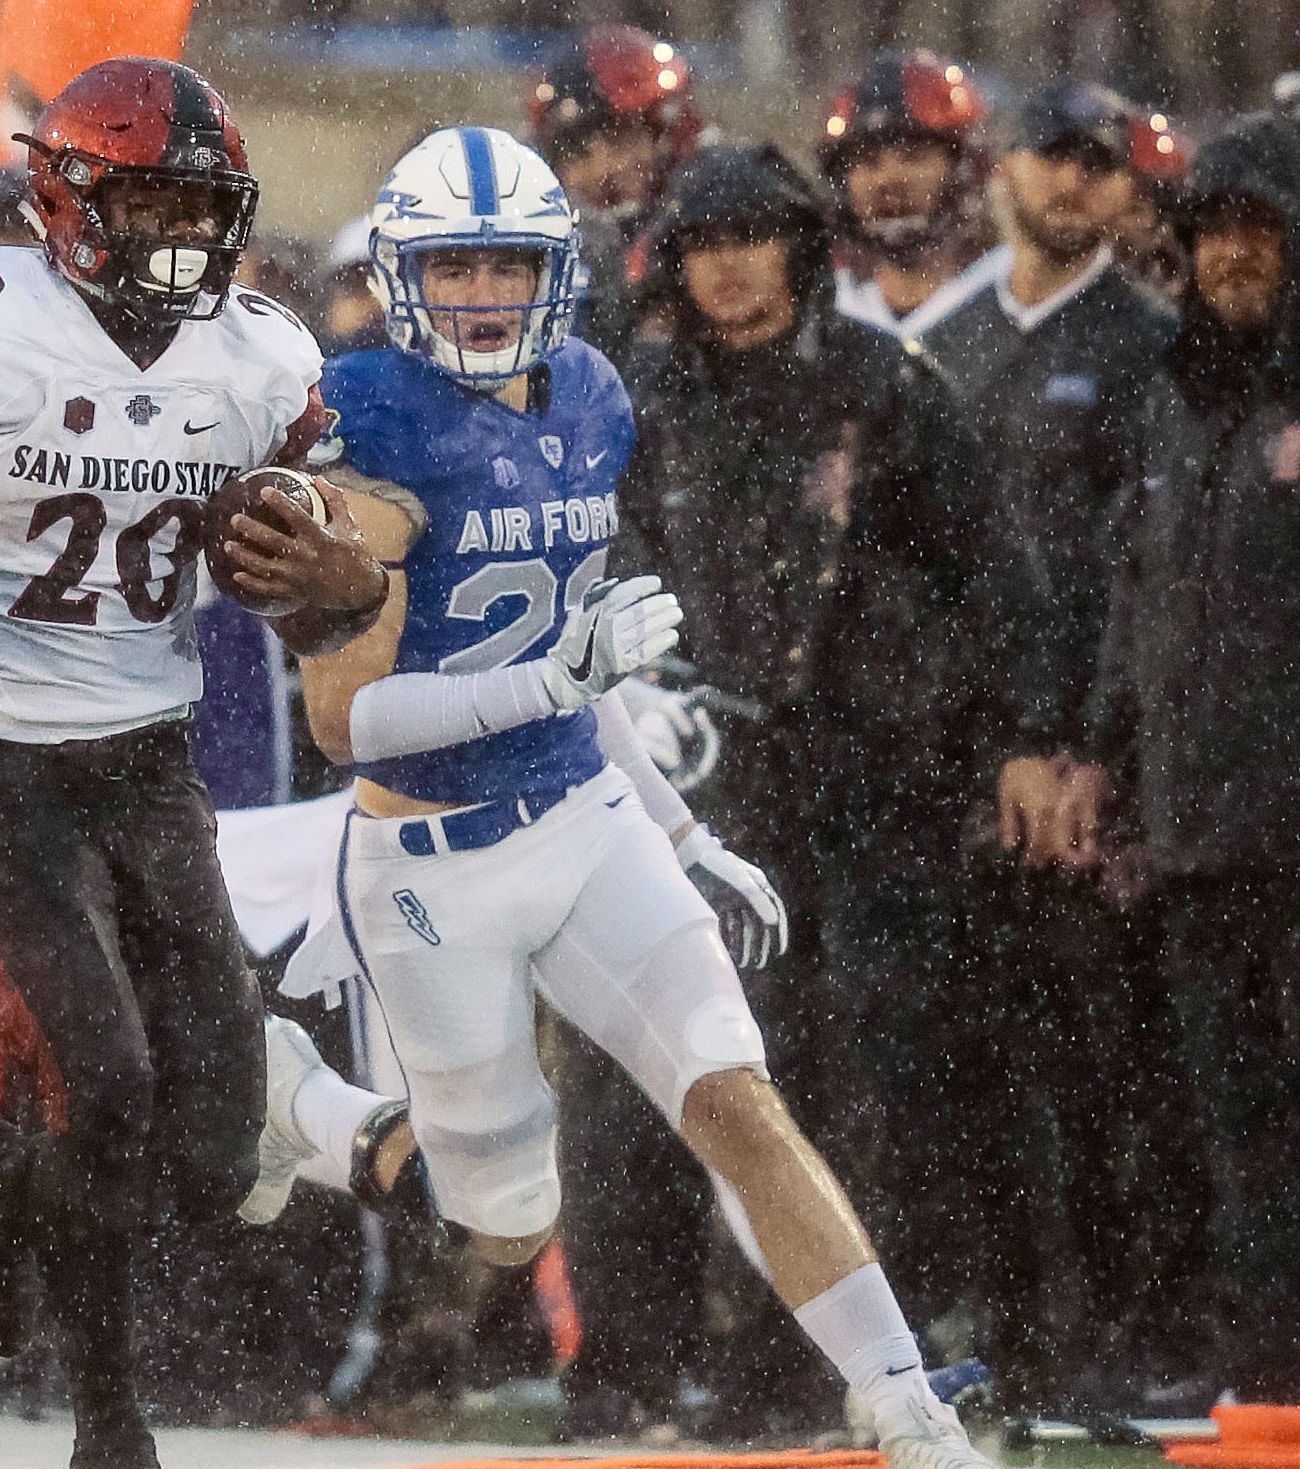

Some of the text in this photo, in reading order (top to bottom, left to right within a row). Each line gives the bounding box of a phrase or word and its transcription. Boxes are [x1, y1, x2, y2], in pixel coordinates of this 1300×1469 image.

[8, 444, 71, 489] SAN
[78, 456, 170, 493] DIEGO
[456, 508, 533, 554] AIR
[7, 492, 203, 626] 20
